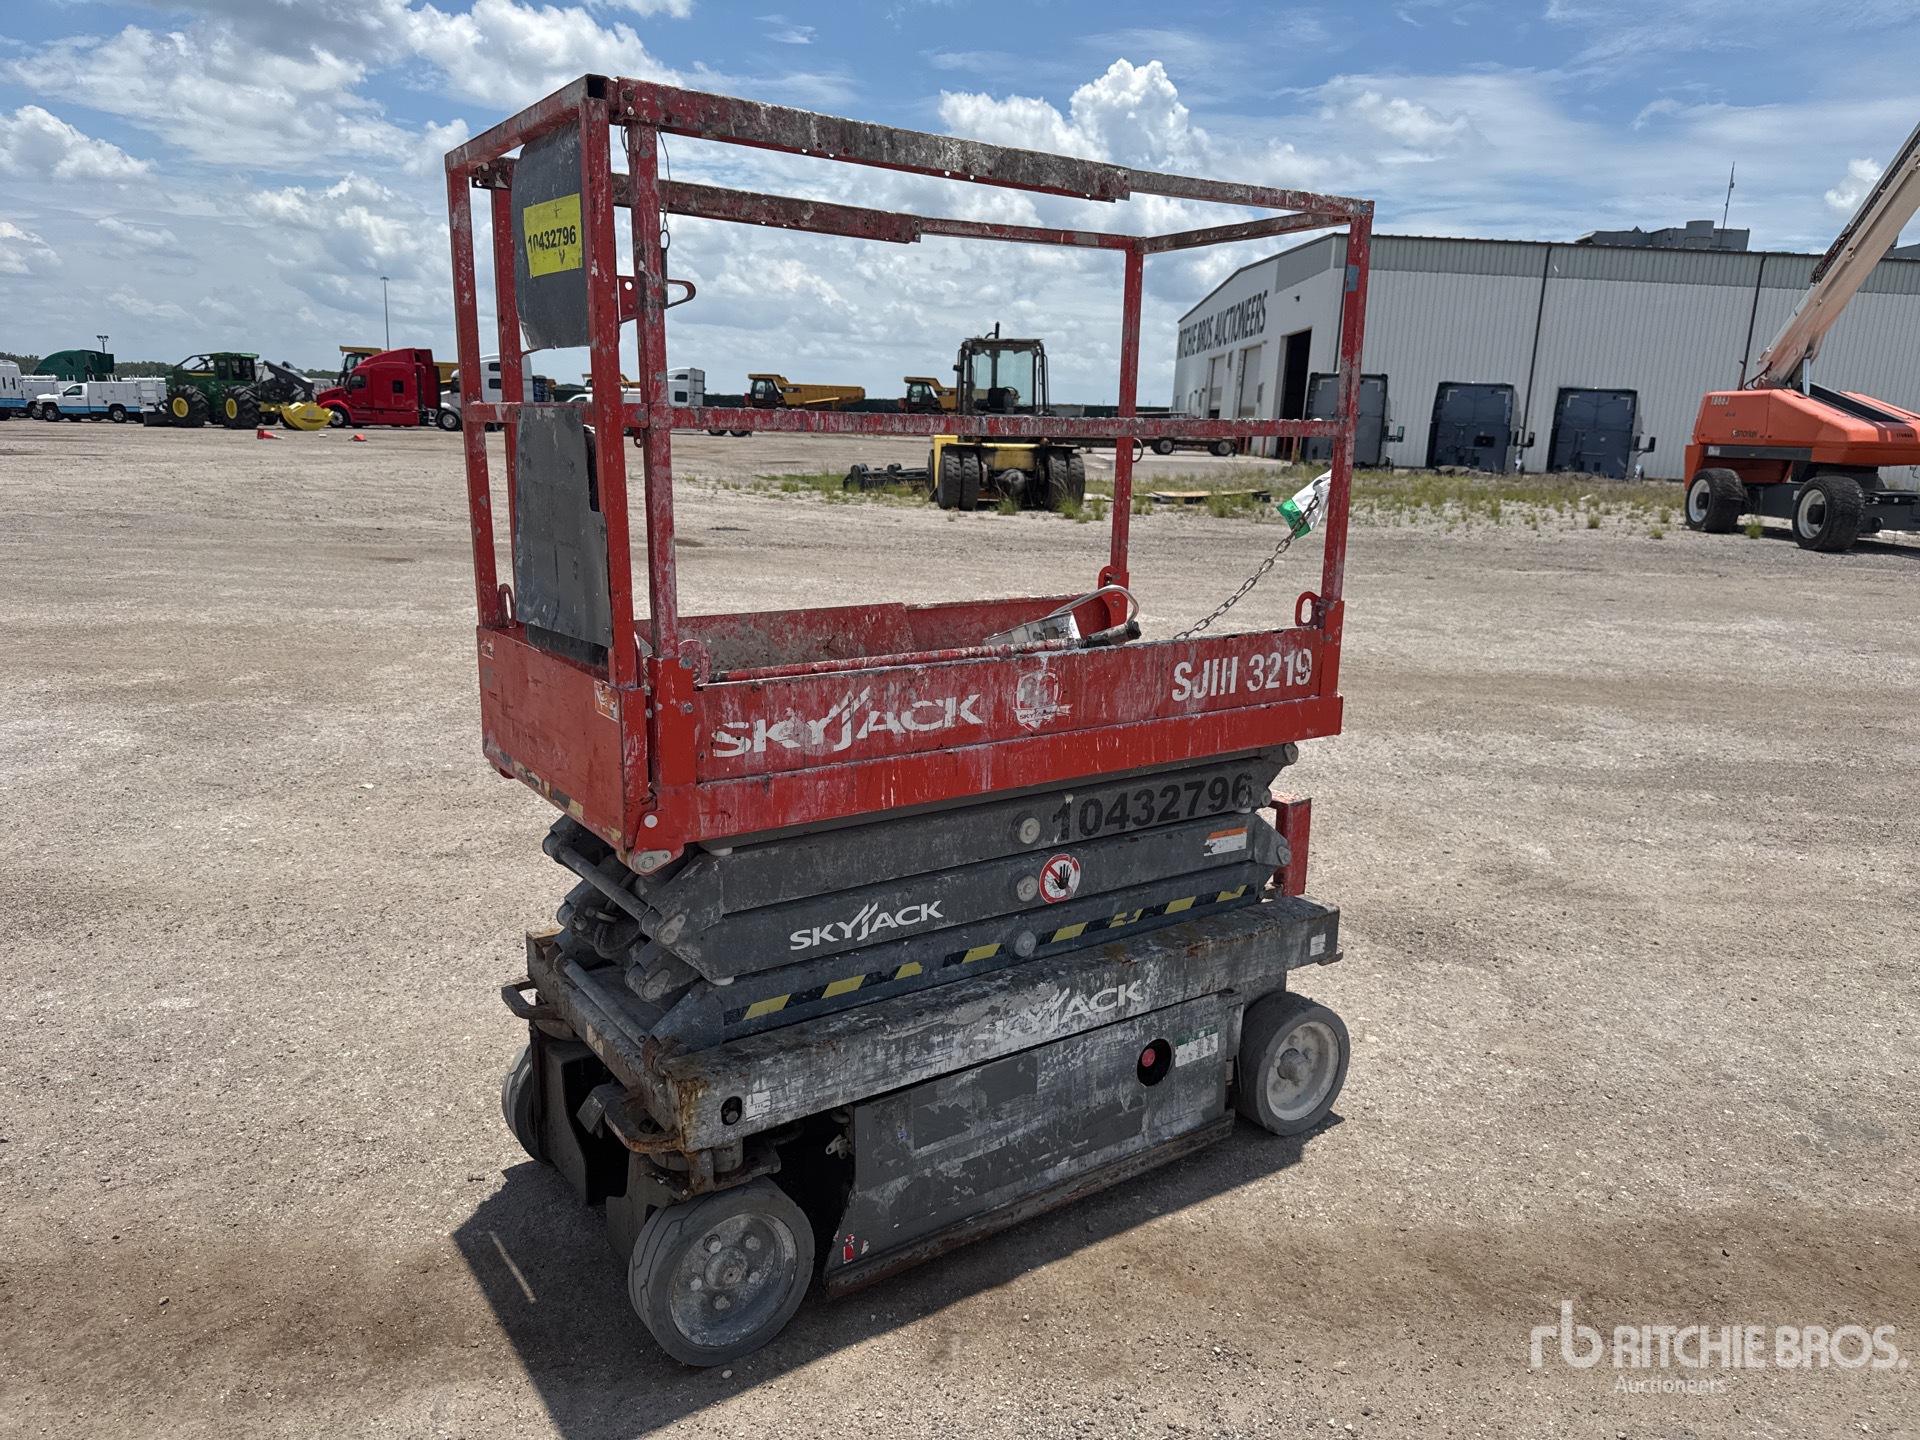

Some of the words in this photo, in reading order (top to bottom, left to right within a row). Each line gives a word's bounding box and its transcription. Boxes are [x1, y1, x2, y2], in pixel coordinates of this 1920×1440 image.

[528, 225, 576, 253] 10432796
[1214, 289, 1268, 347] AUCTIONEERS
[1172, 656, 1238, 701] SJIII
[1247, 648, 1313, 692] 3219
[711, 685, 984, 758] SKYJACK
[1052, 772, 1253, 840] 10432796
[789, 900, 944, 951] SKYJACK
